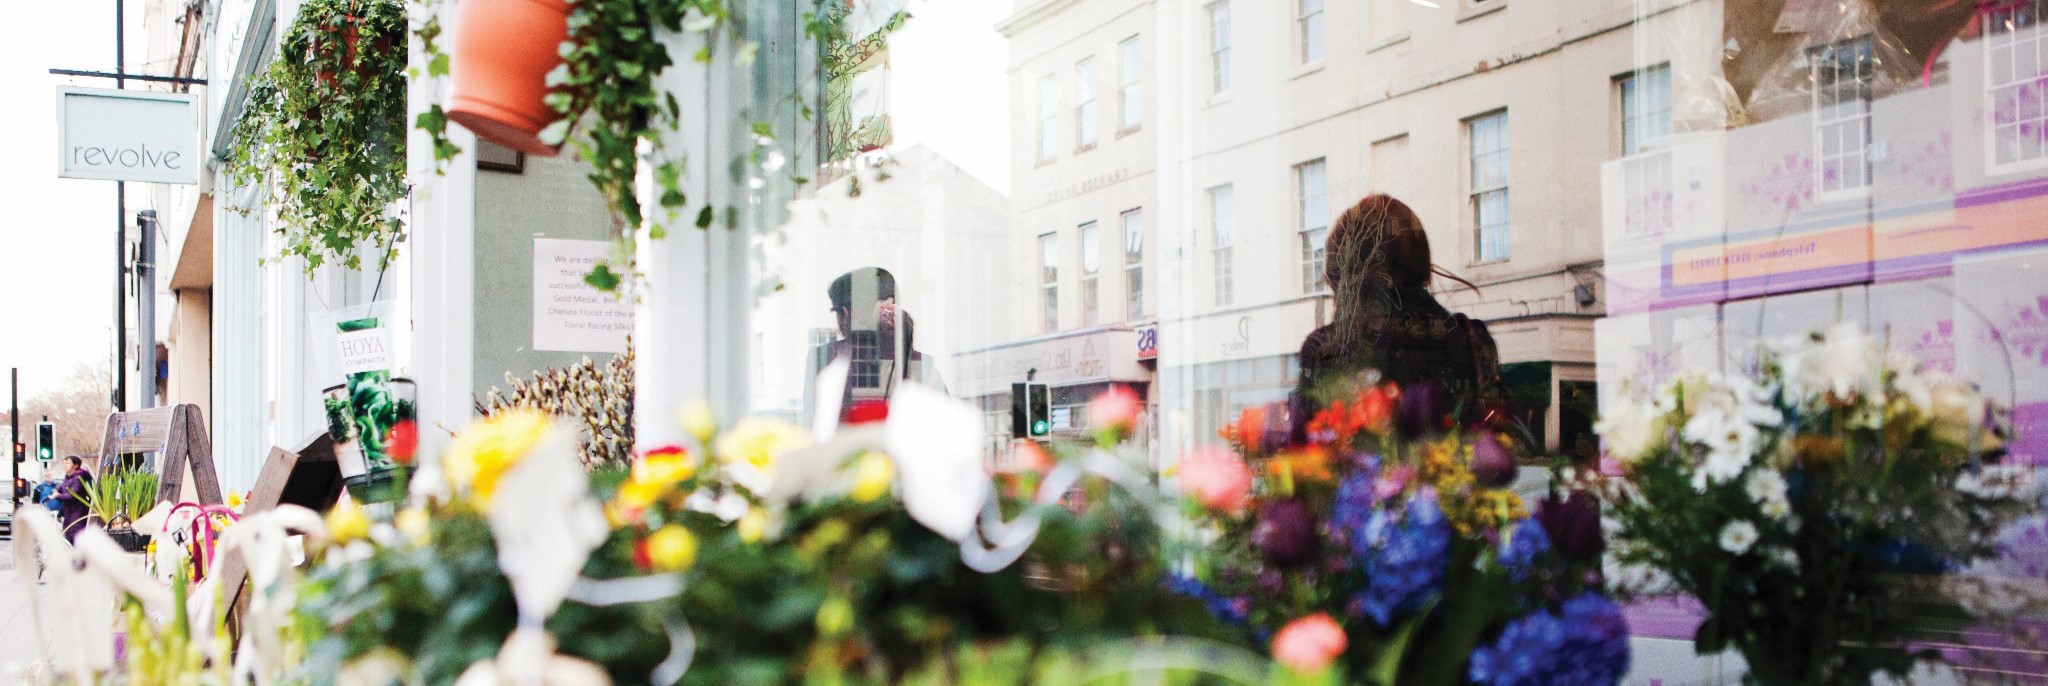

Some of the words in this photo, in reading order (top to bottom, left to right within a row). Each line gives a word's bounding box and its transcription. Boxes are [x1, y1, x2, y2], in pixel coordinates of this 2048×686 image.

[74, 143, 181, 169] revolve
[554, 255, 567, 263] We
[548, 307, 577, 316] Chelsea
[579, 309, 603, 317] Florist
[605, 309, 613, 317] of
[614, 310, 627, 318] the
[564, 321, 585, 329] Floral
[588, 322, 612, 331] Racing
[614, 323, 630, 331] Silks
[341, 336, 385, 357] HOYA
[345, 356, 386, 366] COMPACTA
